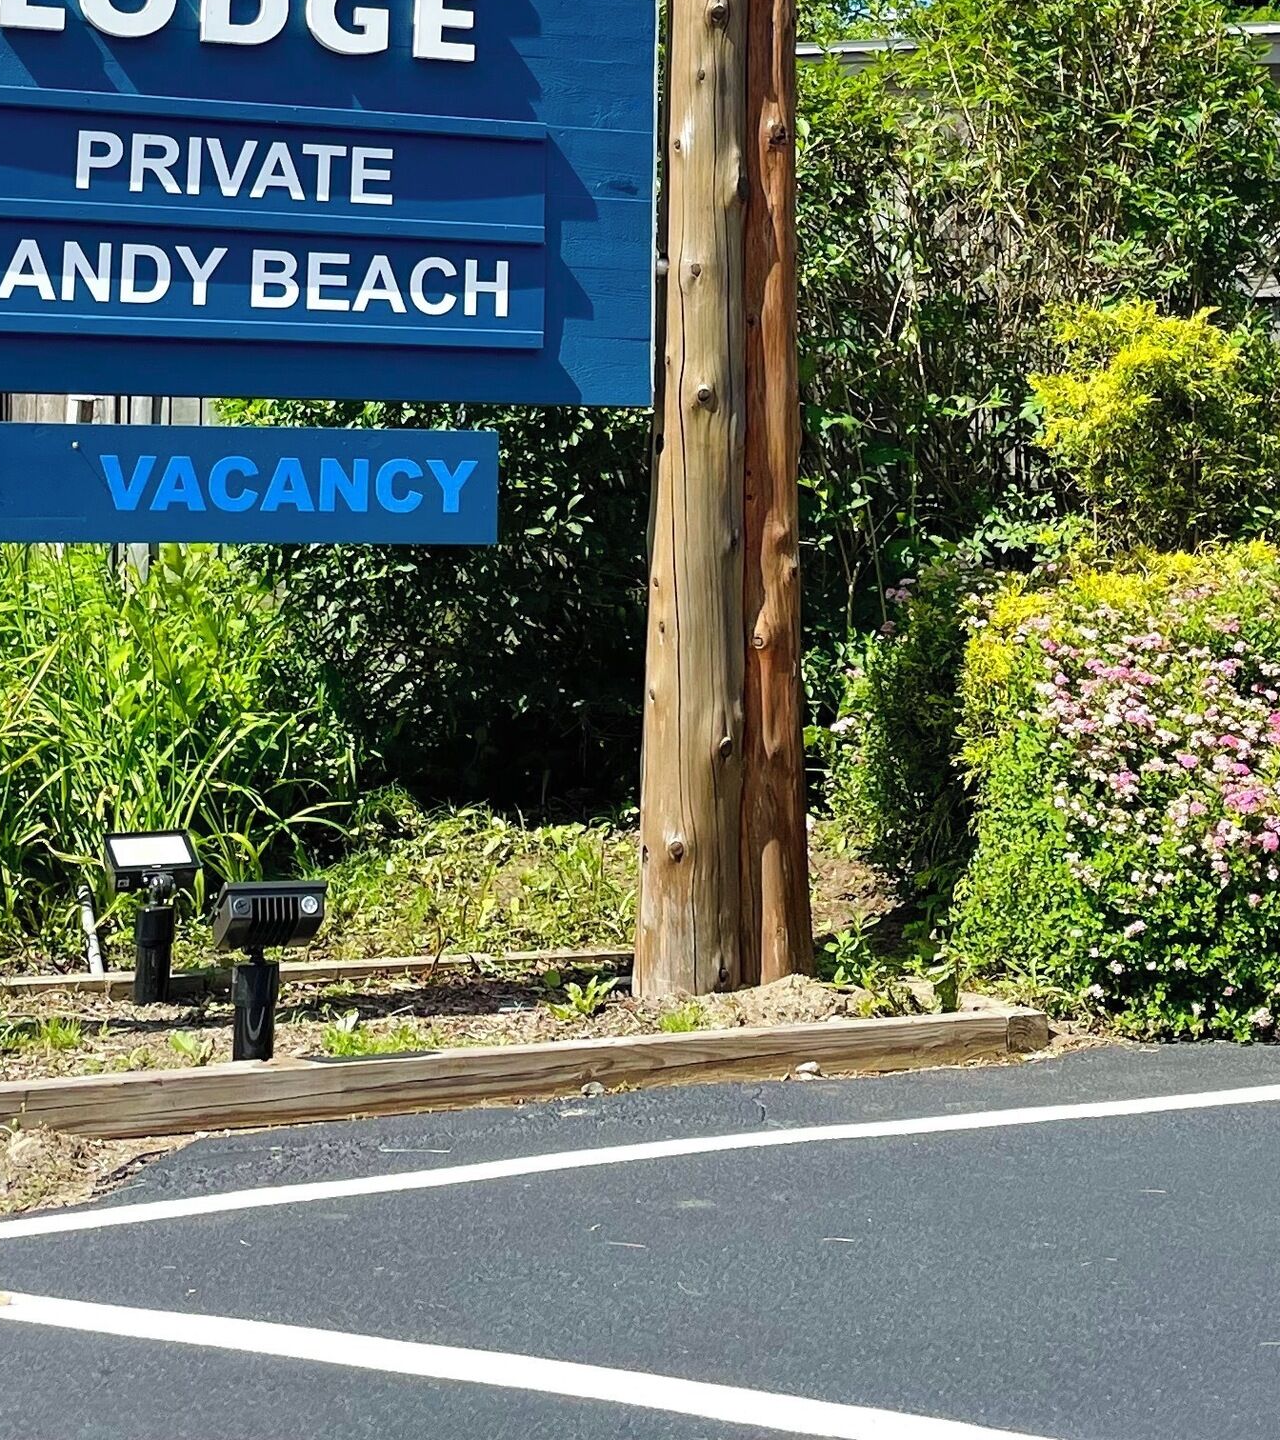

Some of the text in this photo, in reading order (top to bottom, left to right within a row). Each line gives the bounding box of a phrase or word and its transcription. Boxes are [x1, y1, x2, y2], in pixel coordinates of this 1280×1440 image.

[75, 129, 394, 206] PRIVATE
[250, 248, 509, 318] BEACH
[100, 454, 478, 514] VACANCY
